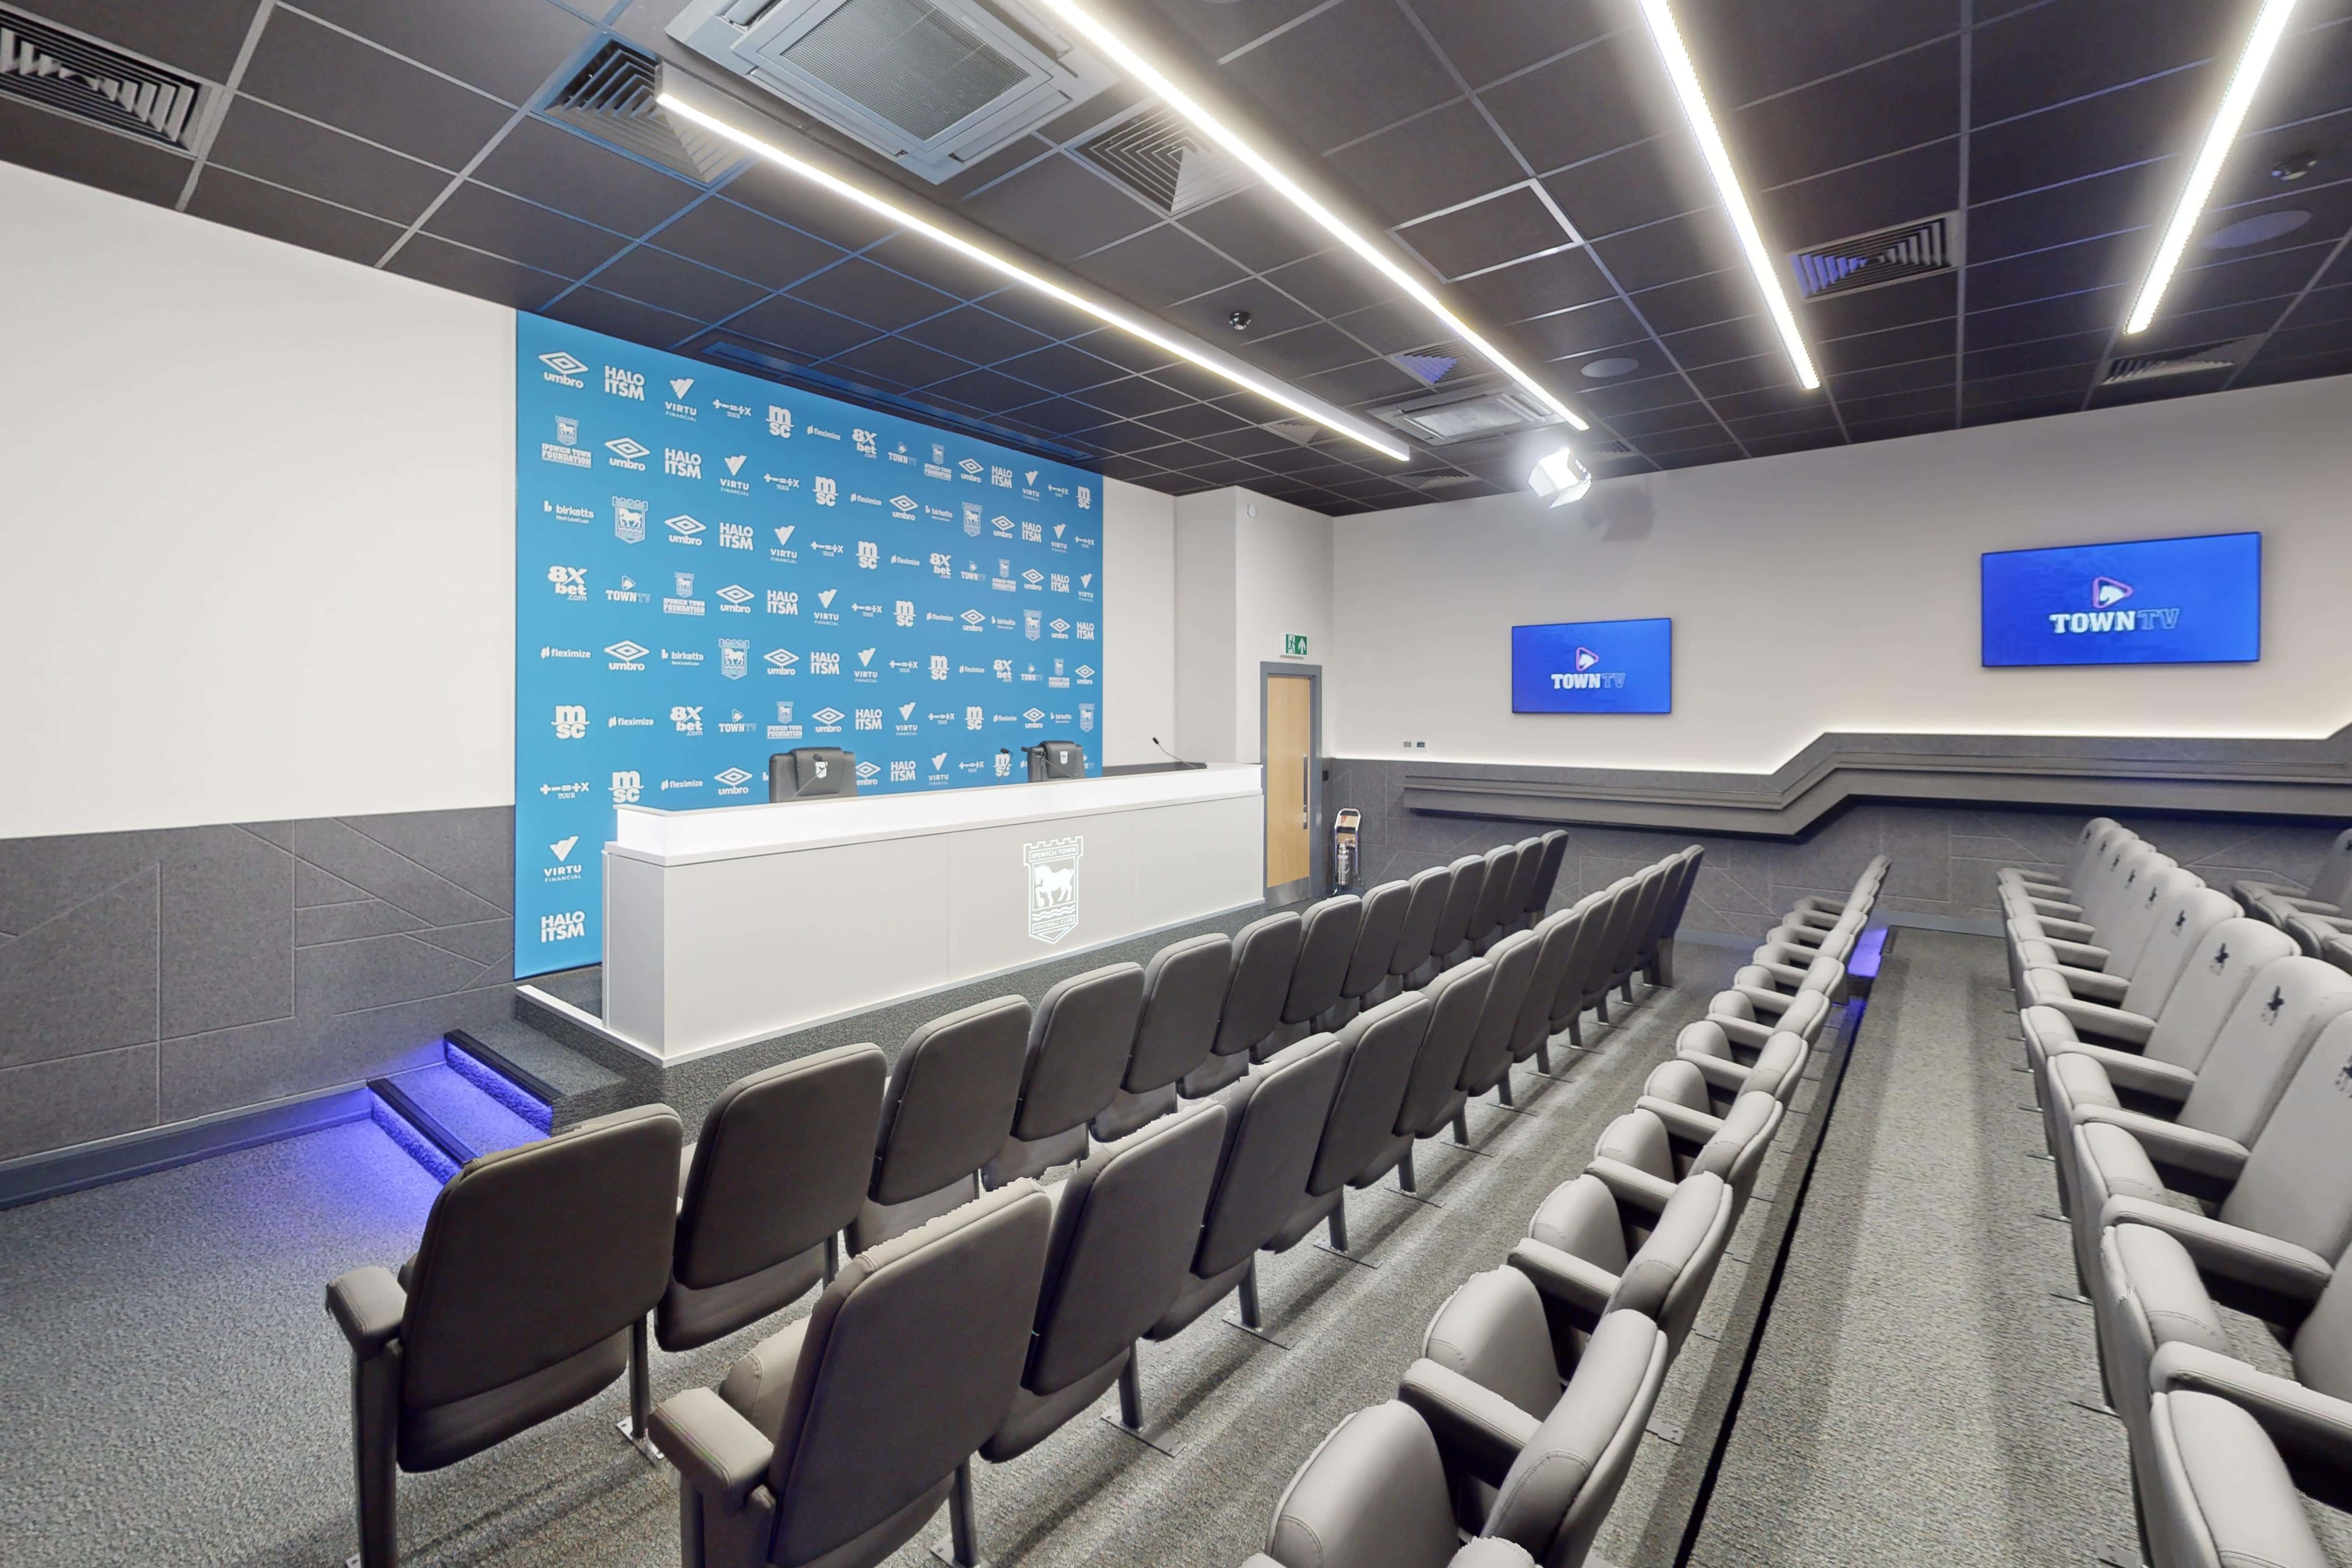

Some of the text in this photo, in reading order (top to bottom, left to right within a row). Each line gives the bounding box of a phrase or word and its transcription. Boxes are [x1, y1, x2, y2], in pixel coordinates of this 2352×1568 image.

[544, 372, 584, 388] umbro
[605, 365, 645, 386] HALO
[605, 379, 645, 401] ITSM
[665, 401, 697, 415] VIRTU
[666, 411, 697, 421] FINANCIAL
[814, 428, 841, 440] fleximize
[665, 448, 701, 465] HALO
[609, 458, 645, 471] umbro
[665, 460, 701, 479] ITSM
[992, 465, 1012, 479] HALO
[961, 473, 981, 483] umbro
[992, 475, 1012, 489] ITSM
[720, 478, 749, 490] VIRTU
[721, 488, 748, 497] FINANCIAL
[1022, 488, 1040, 497] VIRTU
[857, 495, 881, 506] fleximize
[893, 511, 915, 520] umbro
[719, 523, 753, 537] HALO
[1022, 521, 1041, 532] HALO
[994, 530, 1012, 539] umbro
[1022, 531, 1041, 543] ITSM
[669, 535, 702, 546] umbro
[719, 535, 753, 550] ITSM
[771, 549, 797, 558] VIRTU
[897, 557, 920, 566] fleximize
[1051, 573, 1069, 583] HALO
[1051, 581, 1069, 593] ITSM
[767, 589, 798, 602] HALO
[720, 604, 751, 613] umbro
[767, 601, 798, 615] ITSM
[814, 612, 839, 621] VIRTU
[1077, 622, 1094, 630] HALO
[1077, 629, 1094, 640] ITSM
[551, 649, 591, 658] fleximize
[810, 652, 840, 663] HALO
[609, 662, 645, 671] umbro
[810, 662, 840, 674] ITSM
[855, 709, 882, 719] HALO
[855, 718, 882, 730] ITSM
[891, 760, 916, 771] HALO
[891, 769, 916, 781] ITSM
[669, 780, 703, 788] fleximize
[718, 786, 748, 795] umbro
[1032, 849, 1057, 858] IPSWICH
[544, 865, 581, 876] VIRTU
[545, 874, 581, 882] FINANCIAL
[541, 911, 585, 928] HALO
[1035, 921, 1059, 930] FOOTBALL
[541, 923, 585, 942] ITSM
